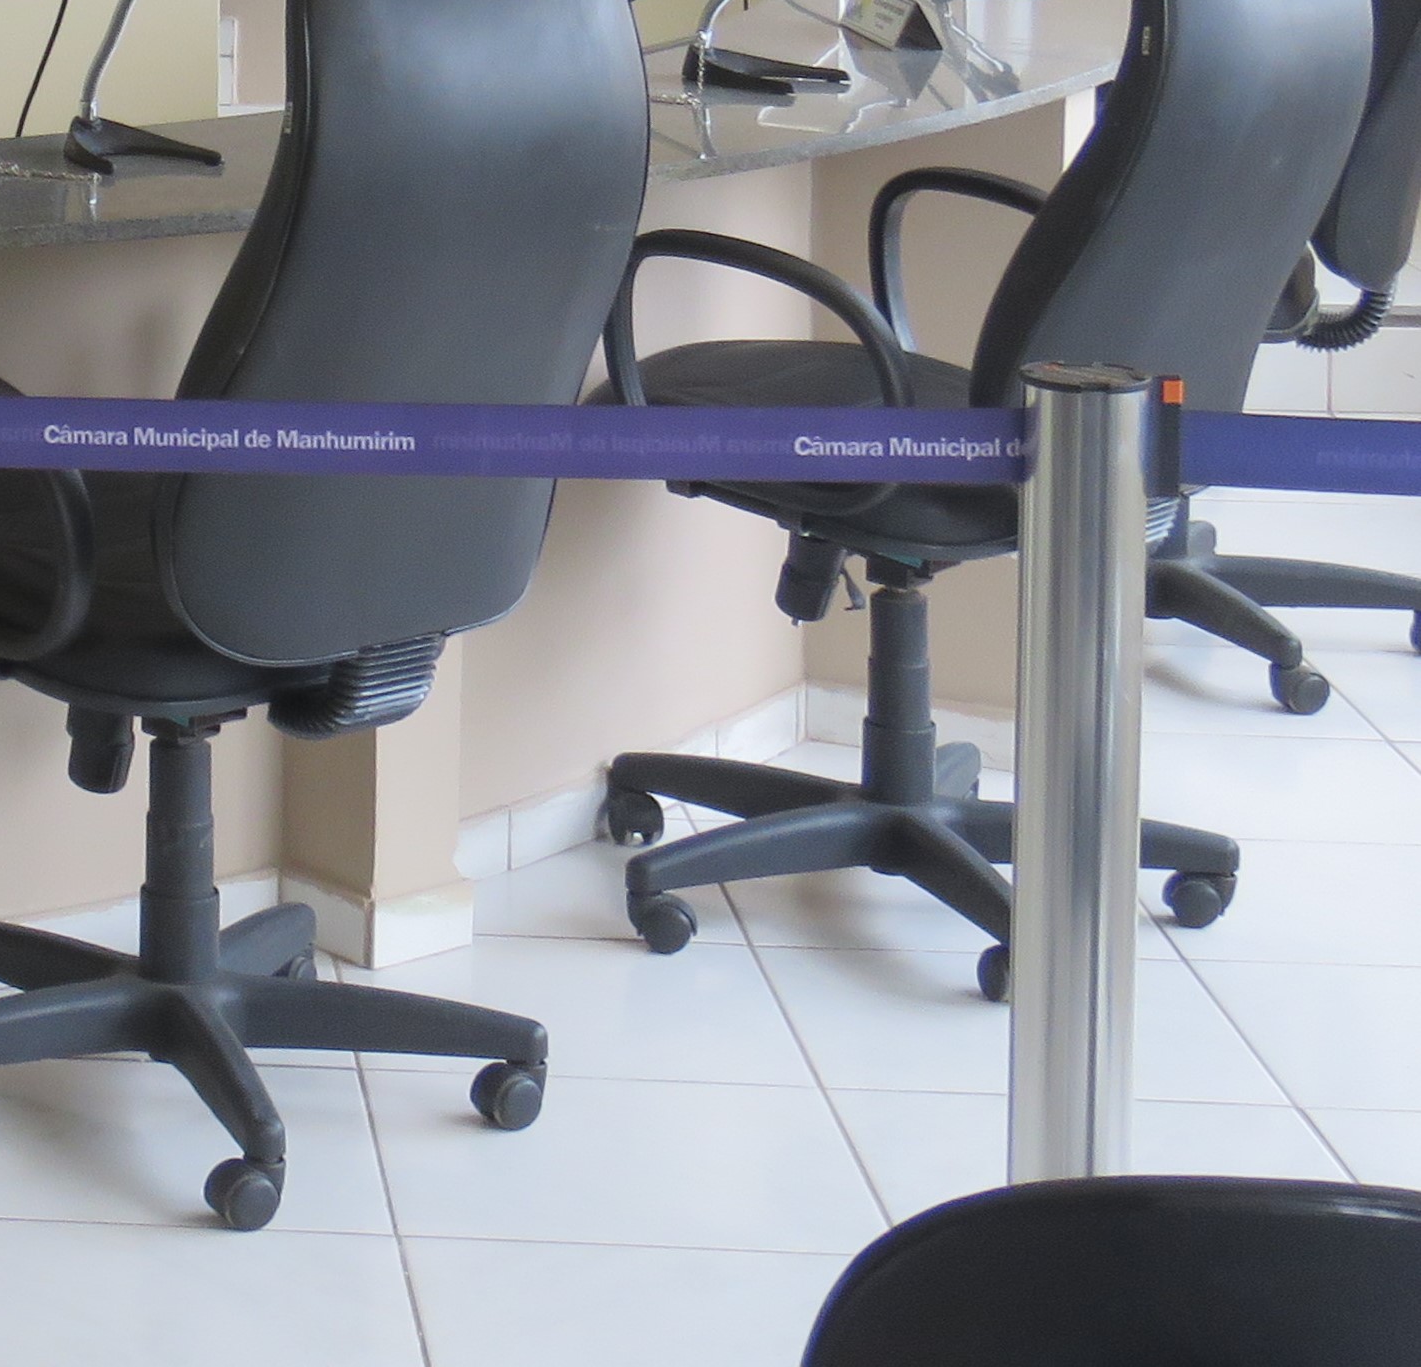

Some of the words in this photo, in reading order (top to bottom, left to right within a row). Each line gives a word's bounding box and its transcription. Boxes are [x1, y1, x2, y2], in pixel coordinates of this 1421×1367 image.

[43, 423, 128, 446] Câmara
[133, 426, 239, 452] Municipal
[244, 428, 272, 449] de
[276, 428, 416, 452] Manhumirim
[793, 435, 884, 458] Câmara
[888, 436, 1001, 462] Municipal
[1006, 438, 1021, 457] d
